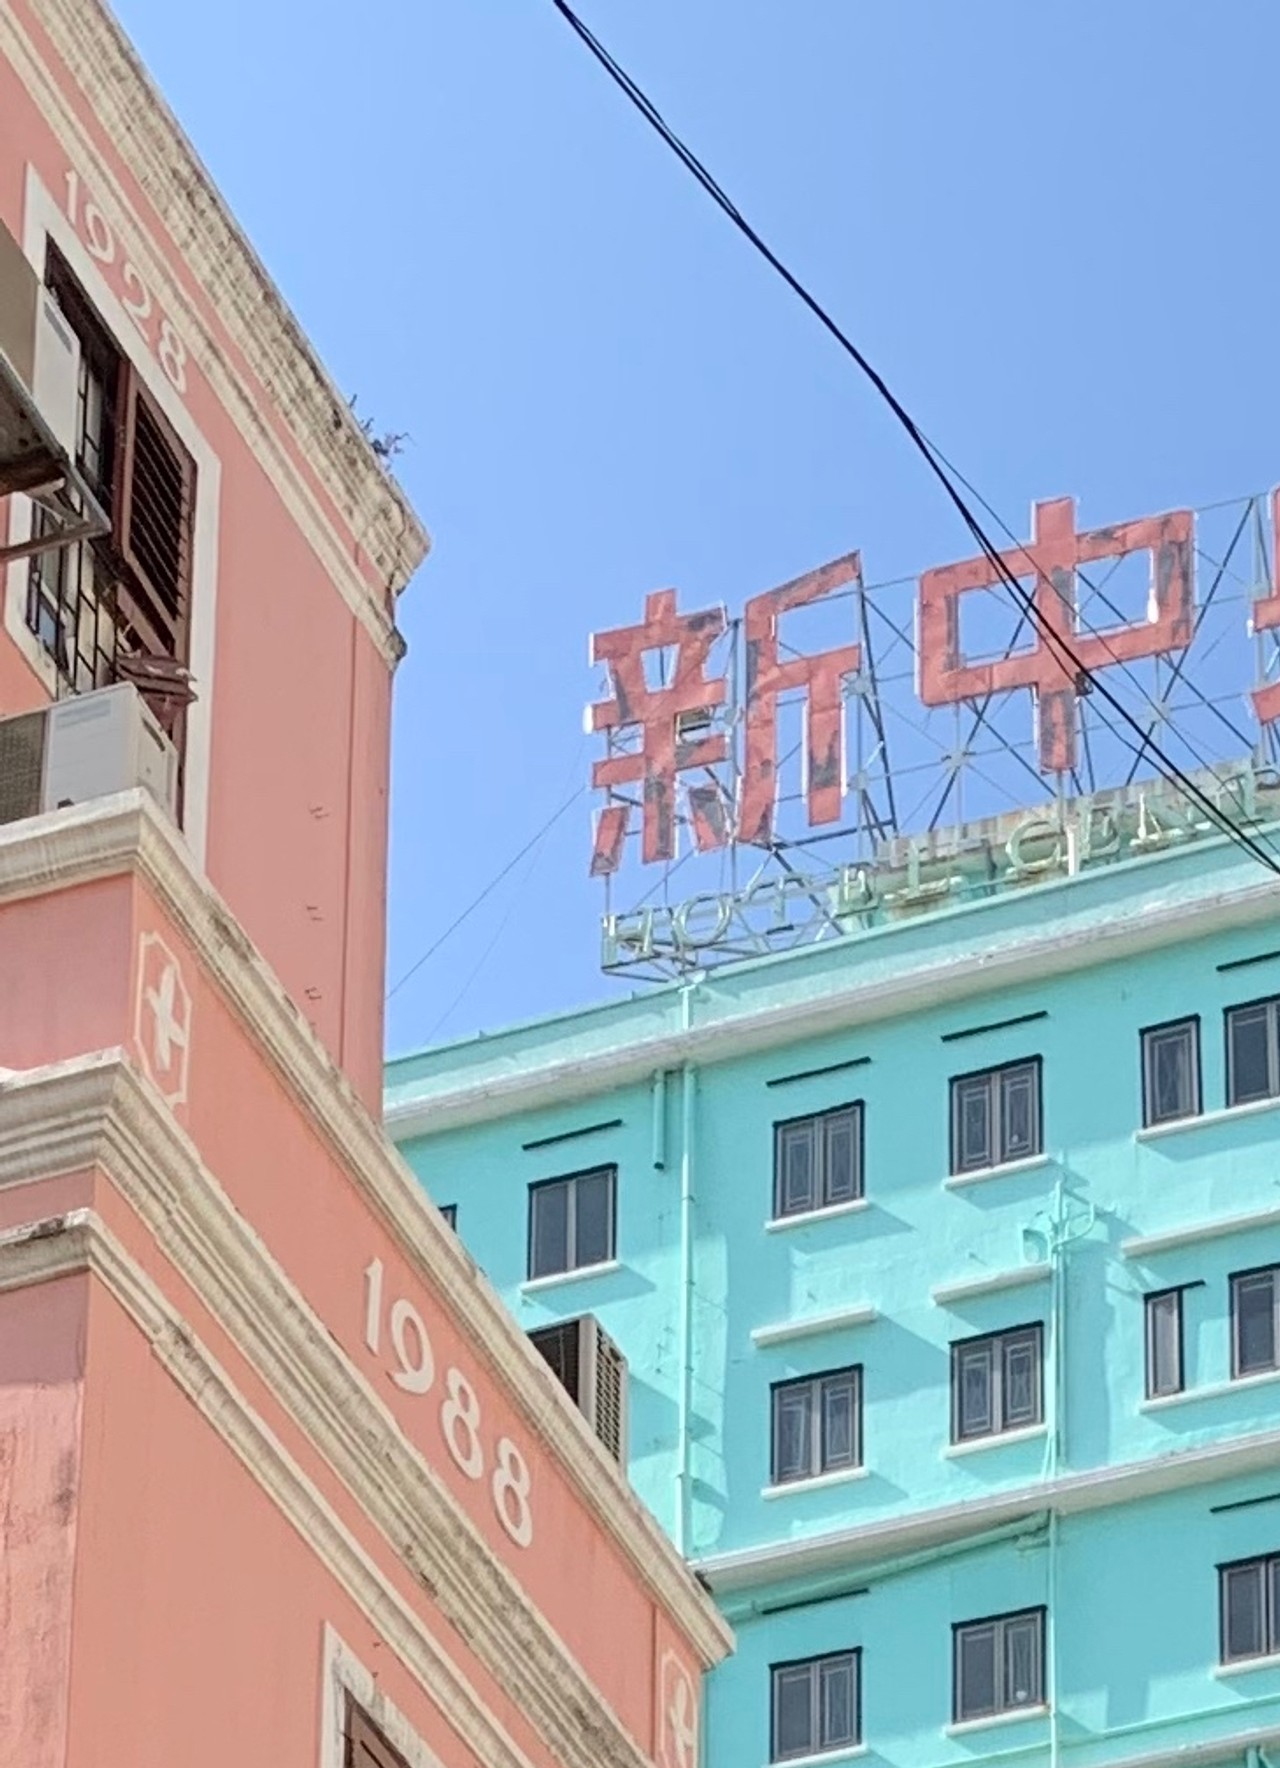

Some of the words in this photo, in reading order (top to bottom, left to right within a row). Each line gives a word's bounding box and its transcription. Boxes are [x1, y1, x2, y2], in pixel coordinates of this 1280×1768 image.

[65, 170, 187, 394] 1928
[601, 842, 962, 966] HOTEL
[364, 1256, 533, 1547] 1988
